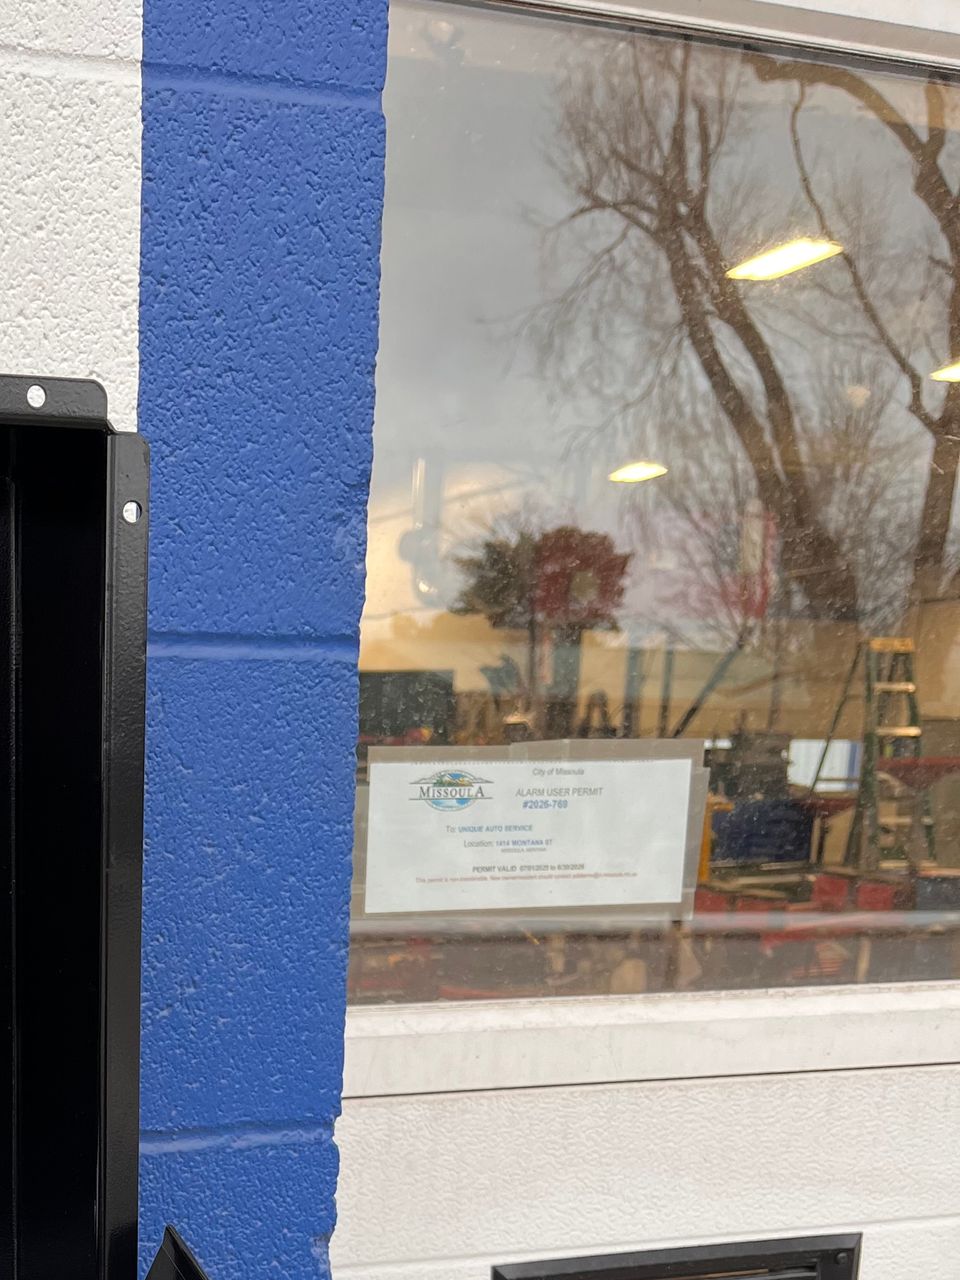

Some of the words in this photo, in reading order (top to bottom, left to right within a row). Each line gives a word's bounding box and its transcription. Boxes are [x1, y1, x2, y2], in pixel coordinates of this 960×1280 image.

[515, 788, 545, 797] ALARM
[547, 788, 570, 797] USER
[572, 787, 603, 797] PERMIT
